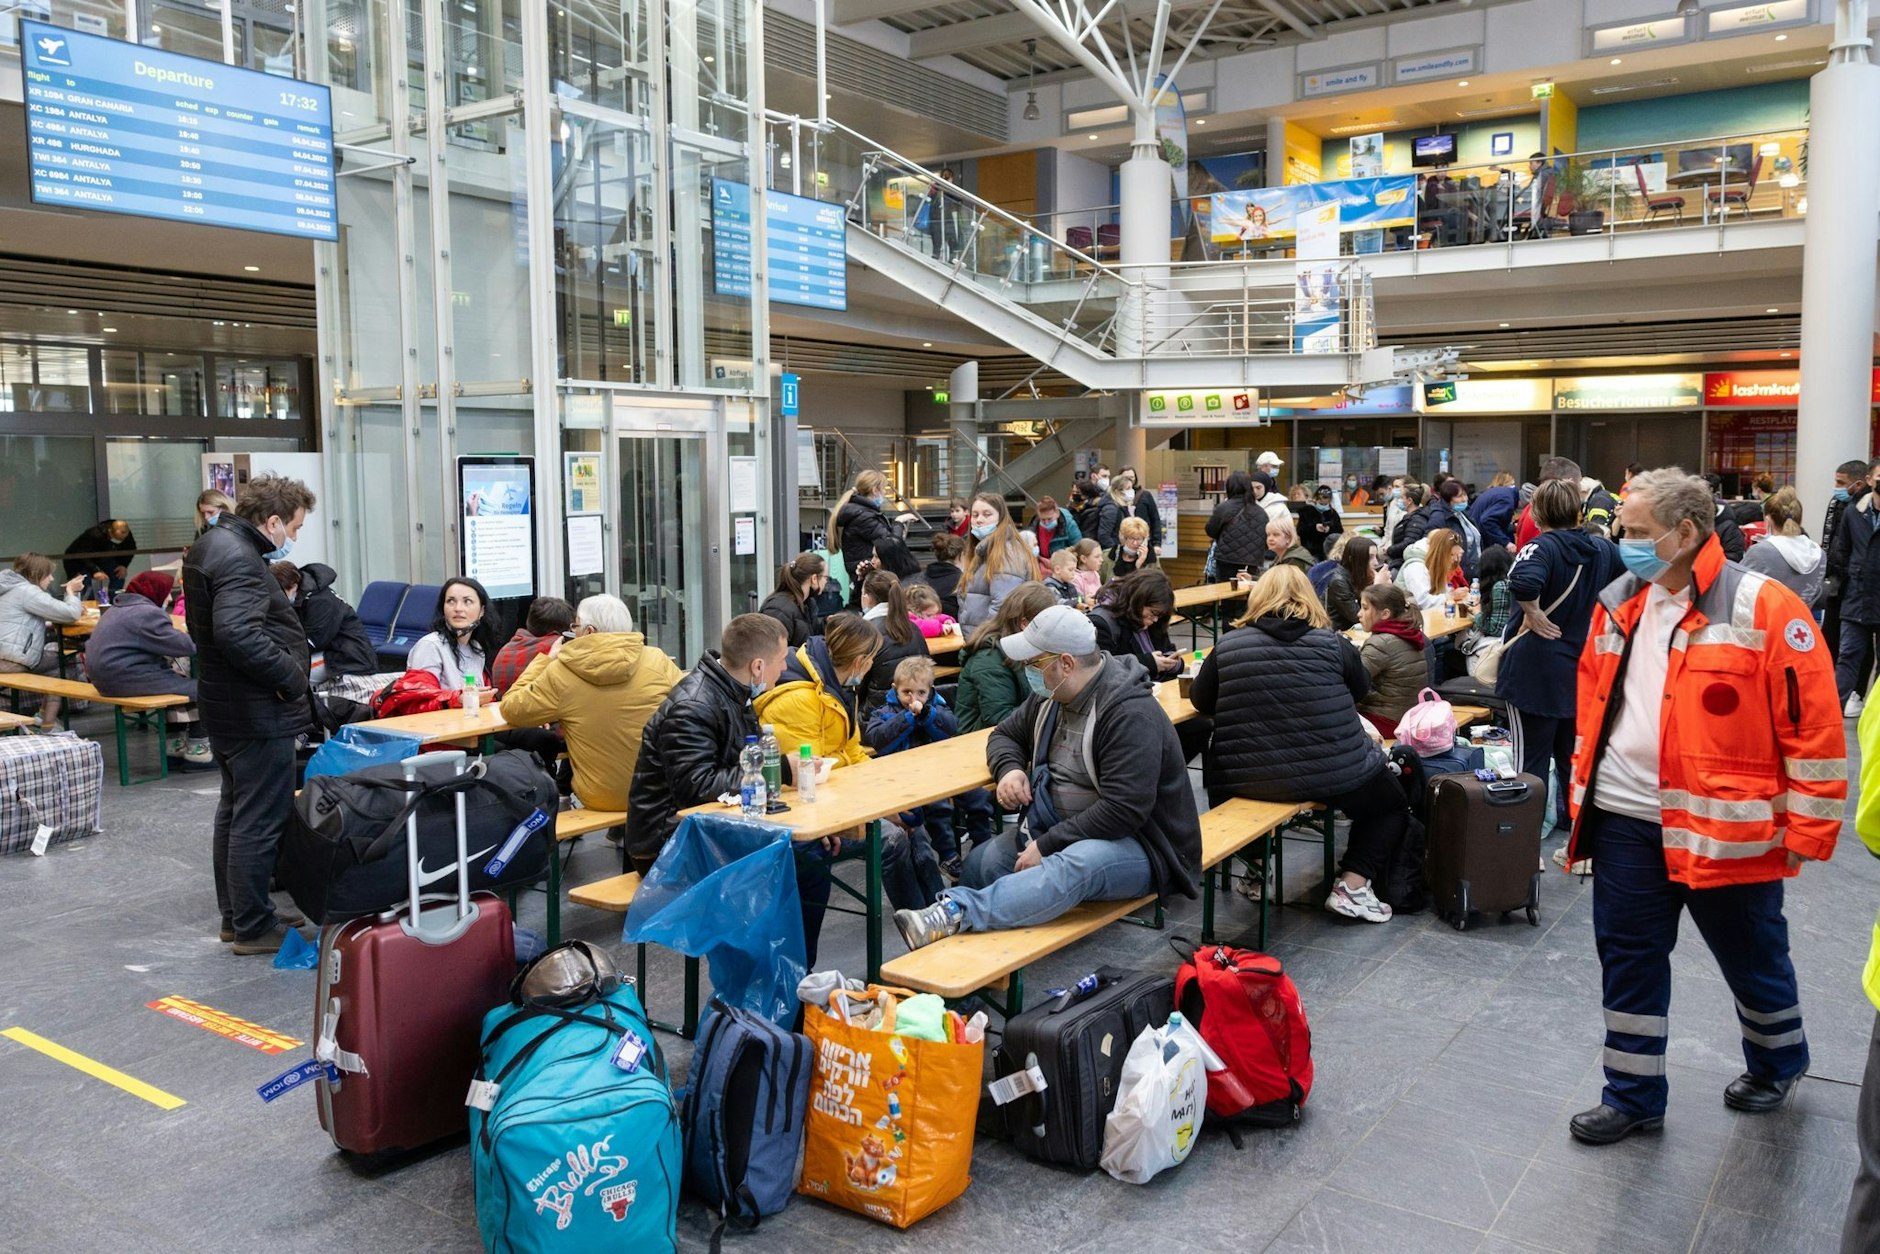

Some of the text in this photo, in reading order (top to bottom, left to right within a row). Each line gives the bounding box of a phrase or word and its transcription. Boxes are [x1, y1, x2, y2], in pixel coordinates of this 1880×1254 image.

[1401, 57, 1469, 74] www.smileandfly.com
[134, 61, 214, 90] Departure
[1326, 74, 1368, 87] smile and fly
[27, 70, 51, 83] flight
[66, 78, 76, 87] to
[175, 100, 199, 111] sched
[226, 110, 254, 121] counter
[263, 117, 279, 127] gate
[297, 124, 320, 135] remark
[28, 86, 41, 97] XR
[67, 94, 93, 106] GRAN
[94, 99, 134, 114] CANARIA
[279, 92, 318, 112] 17:32
[30, 103, 43, 113] XC
[69, 110, 108, 124] ANTALYA
[31, 119, 44, 130] XC
[69, 126, 109, 139] ANTALYA
[32, 135, 45, 146] XR
[70, 142, 121, 157] HURGHADA
[72, 158, 111, 171] ANTALYA
[34, 168, 47, 178] XC
[73, 174, 112, 187] ANTALYA
[74, 189, 113, 203] ANTALYA
[502, 501, 522, 511] Regeln
[526, 813, 544, 830] IOM
[235, 1034, 264, 1046] BITTE
[262, 1081, 284, 1097] IOM
[525, 1157, 562, 1193] Chicago
[533, 1133, 629, 1231] Bulls
[601, 1180, 637, 1197] CHICAGO
